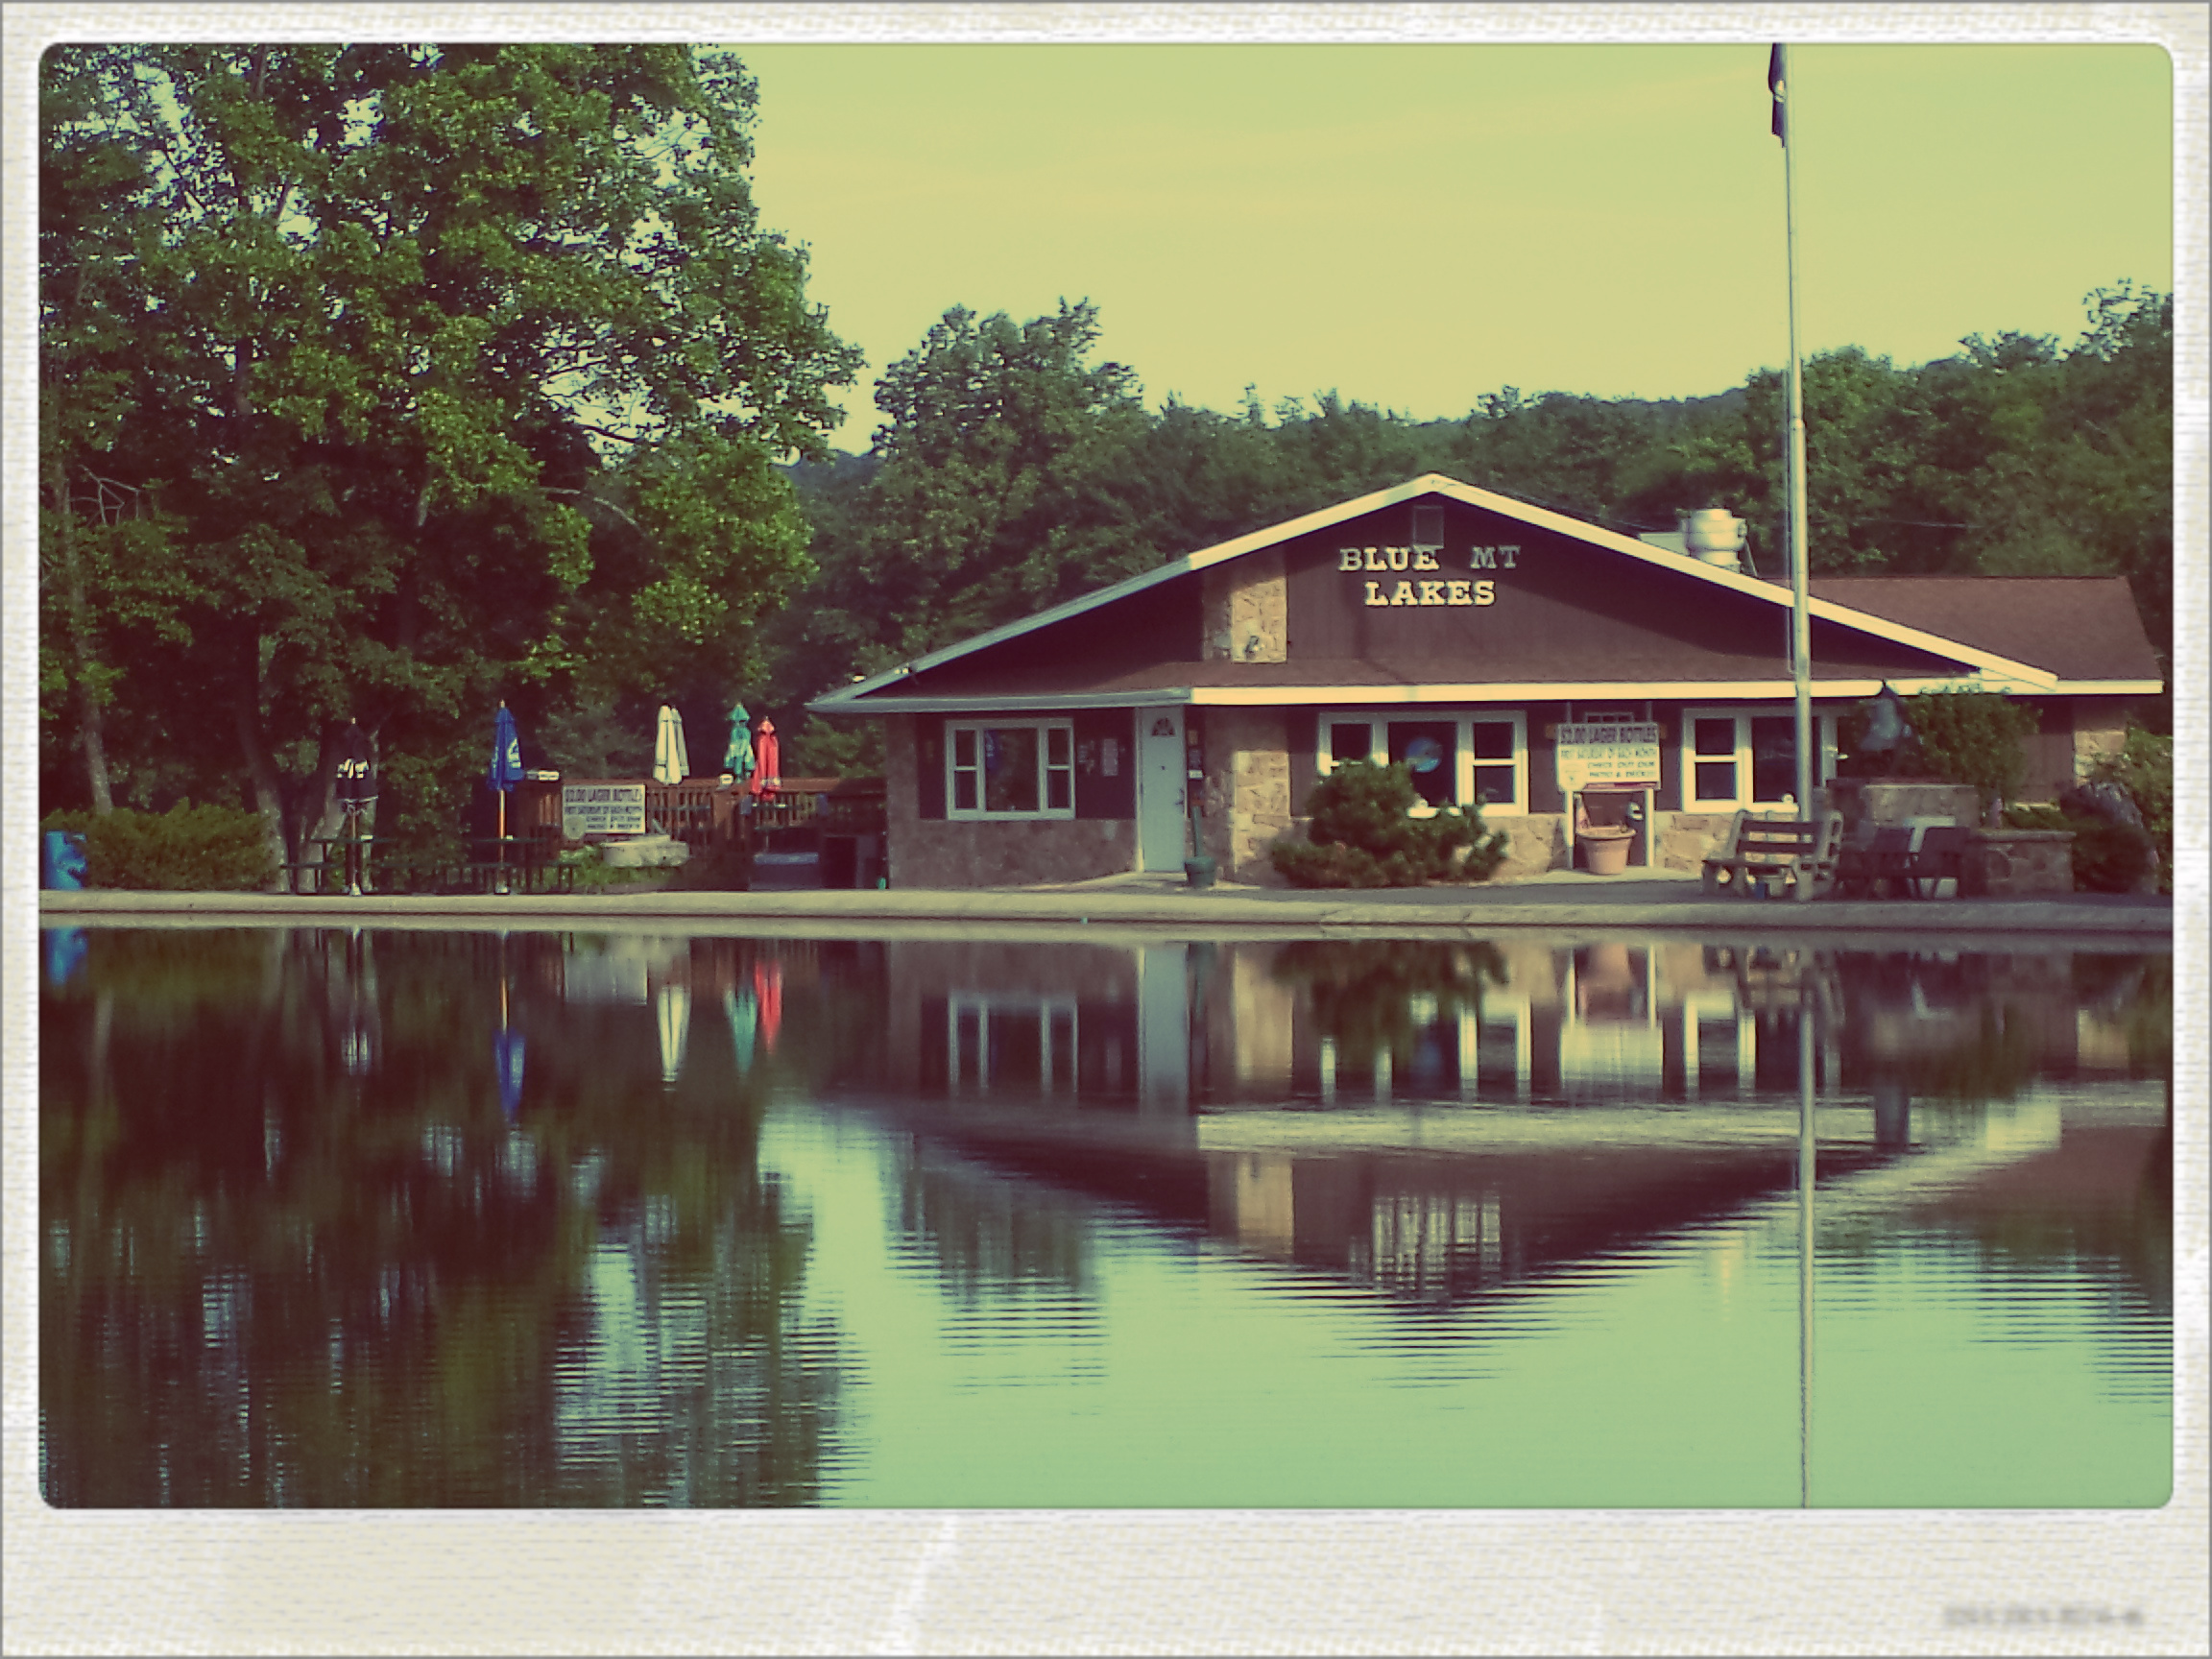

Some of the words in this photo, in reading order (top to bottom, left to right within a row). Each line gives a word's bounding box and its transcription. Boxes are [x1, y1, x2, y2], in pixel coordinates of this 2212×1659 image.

[1337, 546, 1440, 571] BLUE
[1470, 545, 1521, 569] MT
[1364, 580, 1496, 606] LAKES
